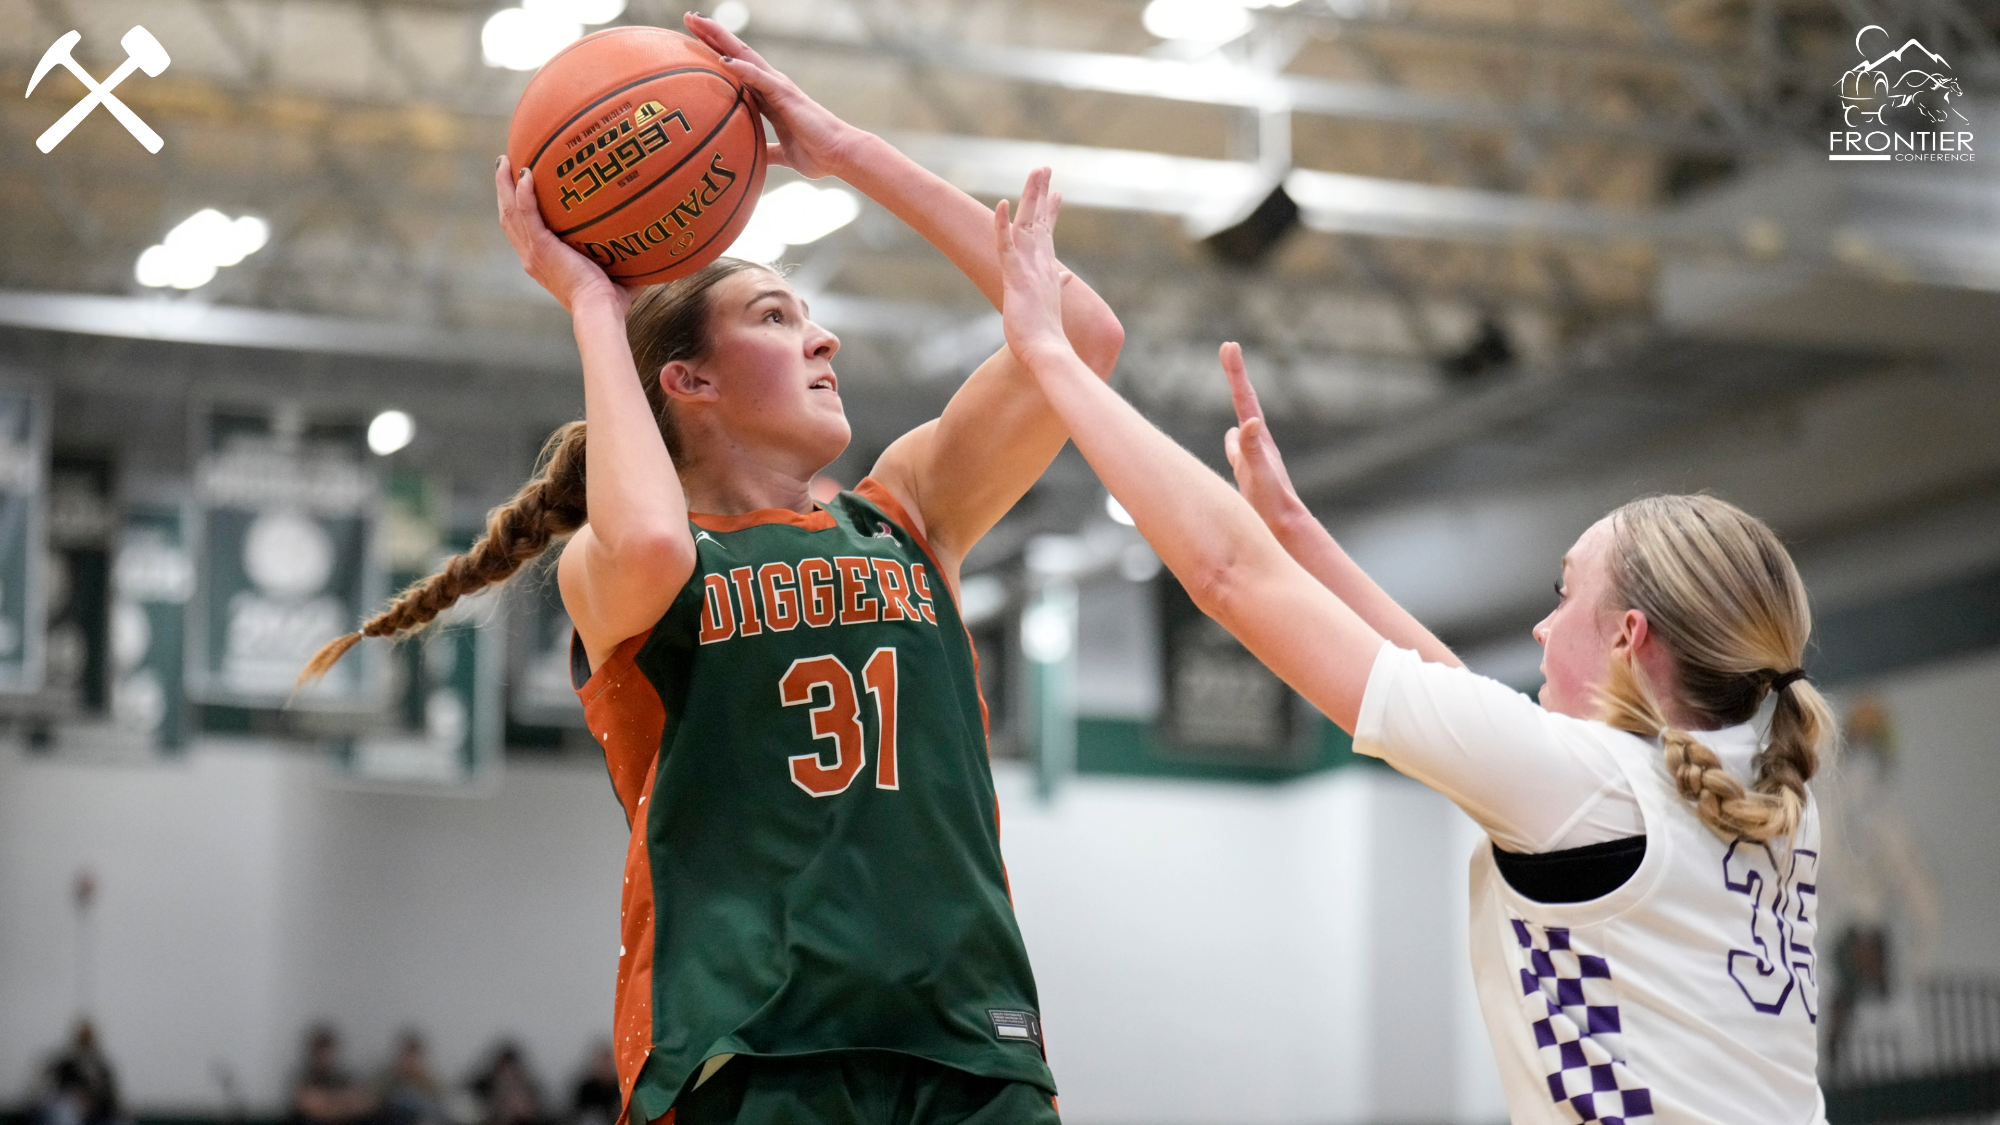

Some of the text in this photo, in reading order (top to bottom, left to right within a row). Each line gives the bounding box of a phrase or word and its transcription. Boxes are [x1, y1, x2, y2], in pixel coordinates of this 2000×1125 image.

[556, 117, 634, 179] 1000
[559, 108, 692, 213] LEGACY
[565, 101, 633, 150] OFFICIAL GAME BALL
[583, 151, 736, 267] SPALDING
[699, 556, 938, 645] DIGGERS
[778, 647, 900, 798] 31
[1722, 834, 1817, 1025] 35
